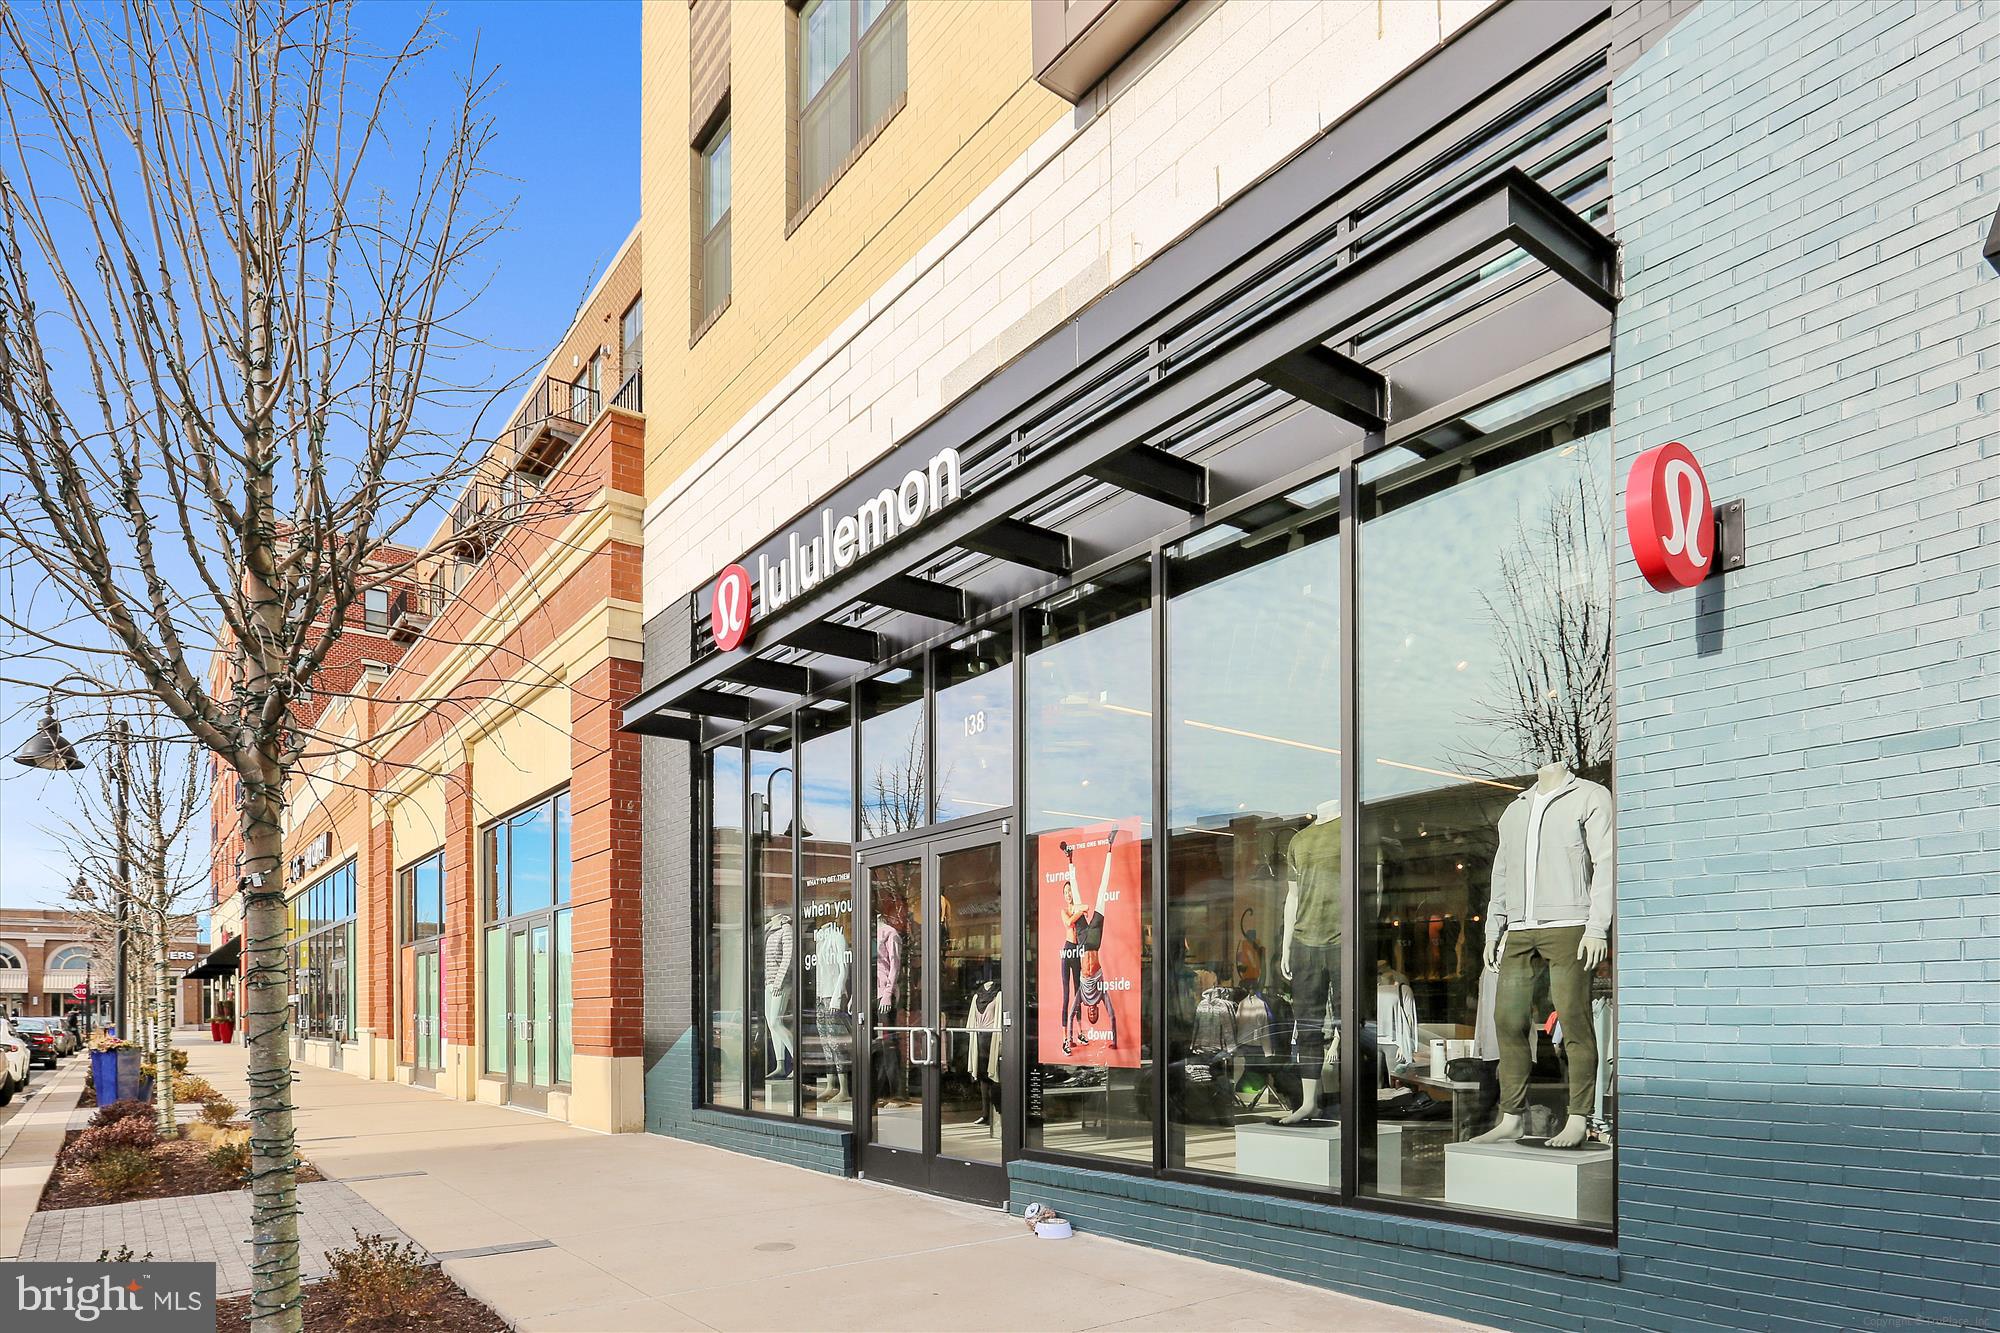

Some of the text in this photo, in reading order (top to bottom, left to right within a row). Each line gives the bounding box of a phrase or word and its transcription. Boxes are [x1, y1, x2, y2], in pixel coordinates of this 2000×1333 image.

[759, 447, 961, 617] lululemon
[964, 711, 984, 737] 138
[1086, 840, 1097, 848] ONE
[806, 877, 820, 887] WHAT
[827, 875, 837, 883] GET
[837, 872, 851, 881] THEM
[1102, 890, 1121, 902] our
[803, 898, 853, 919] when you
[168, 950, 196, 960] ERS
[1059, 944, 1085, 959] world
[804, 953, 820, 971] ge
[1096, 977, 1131, 994] upside
[1087, 1027, 1114, 1041] down
